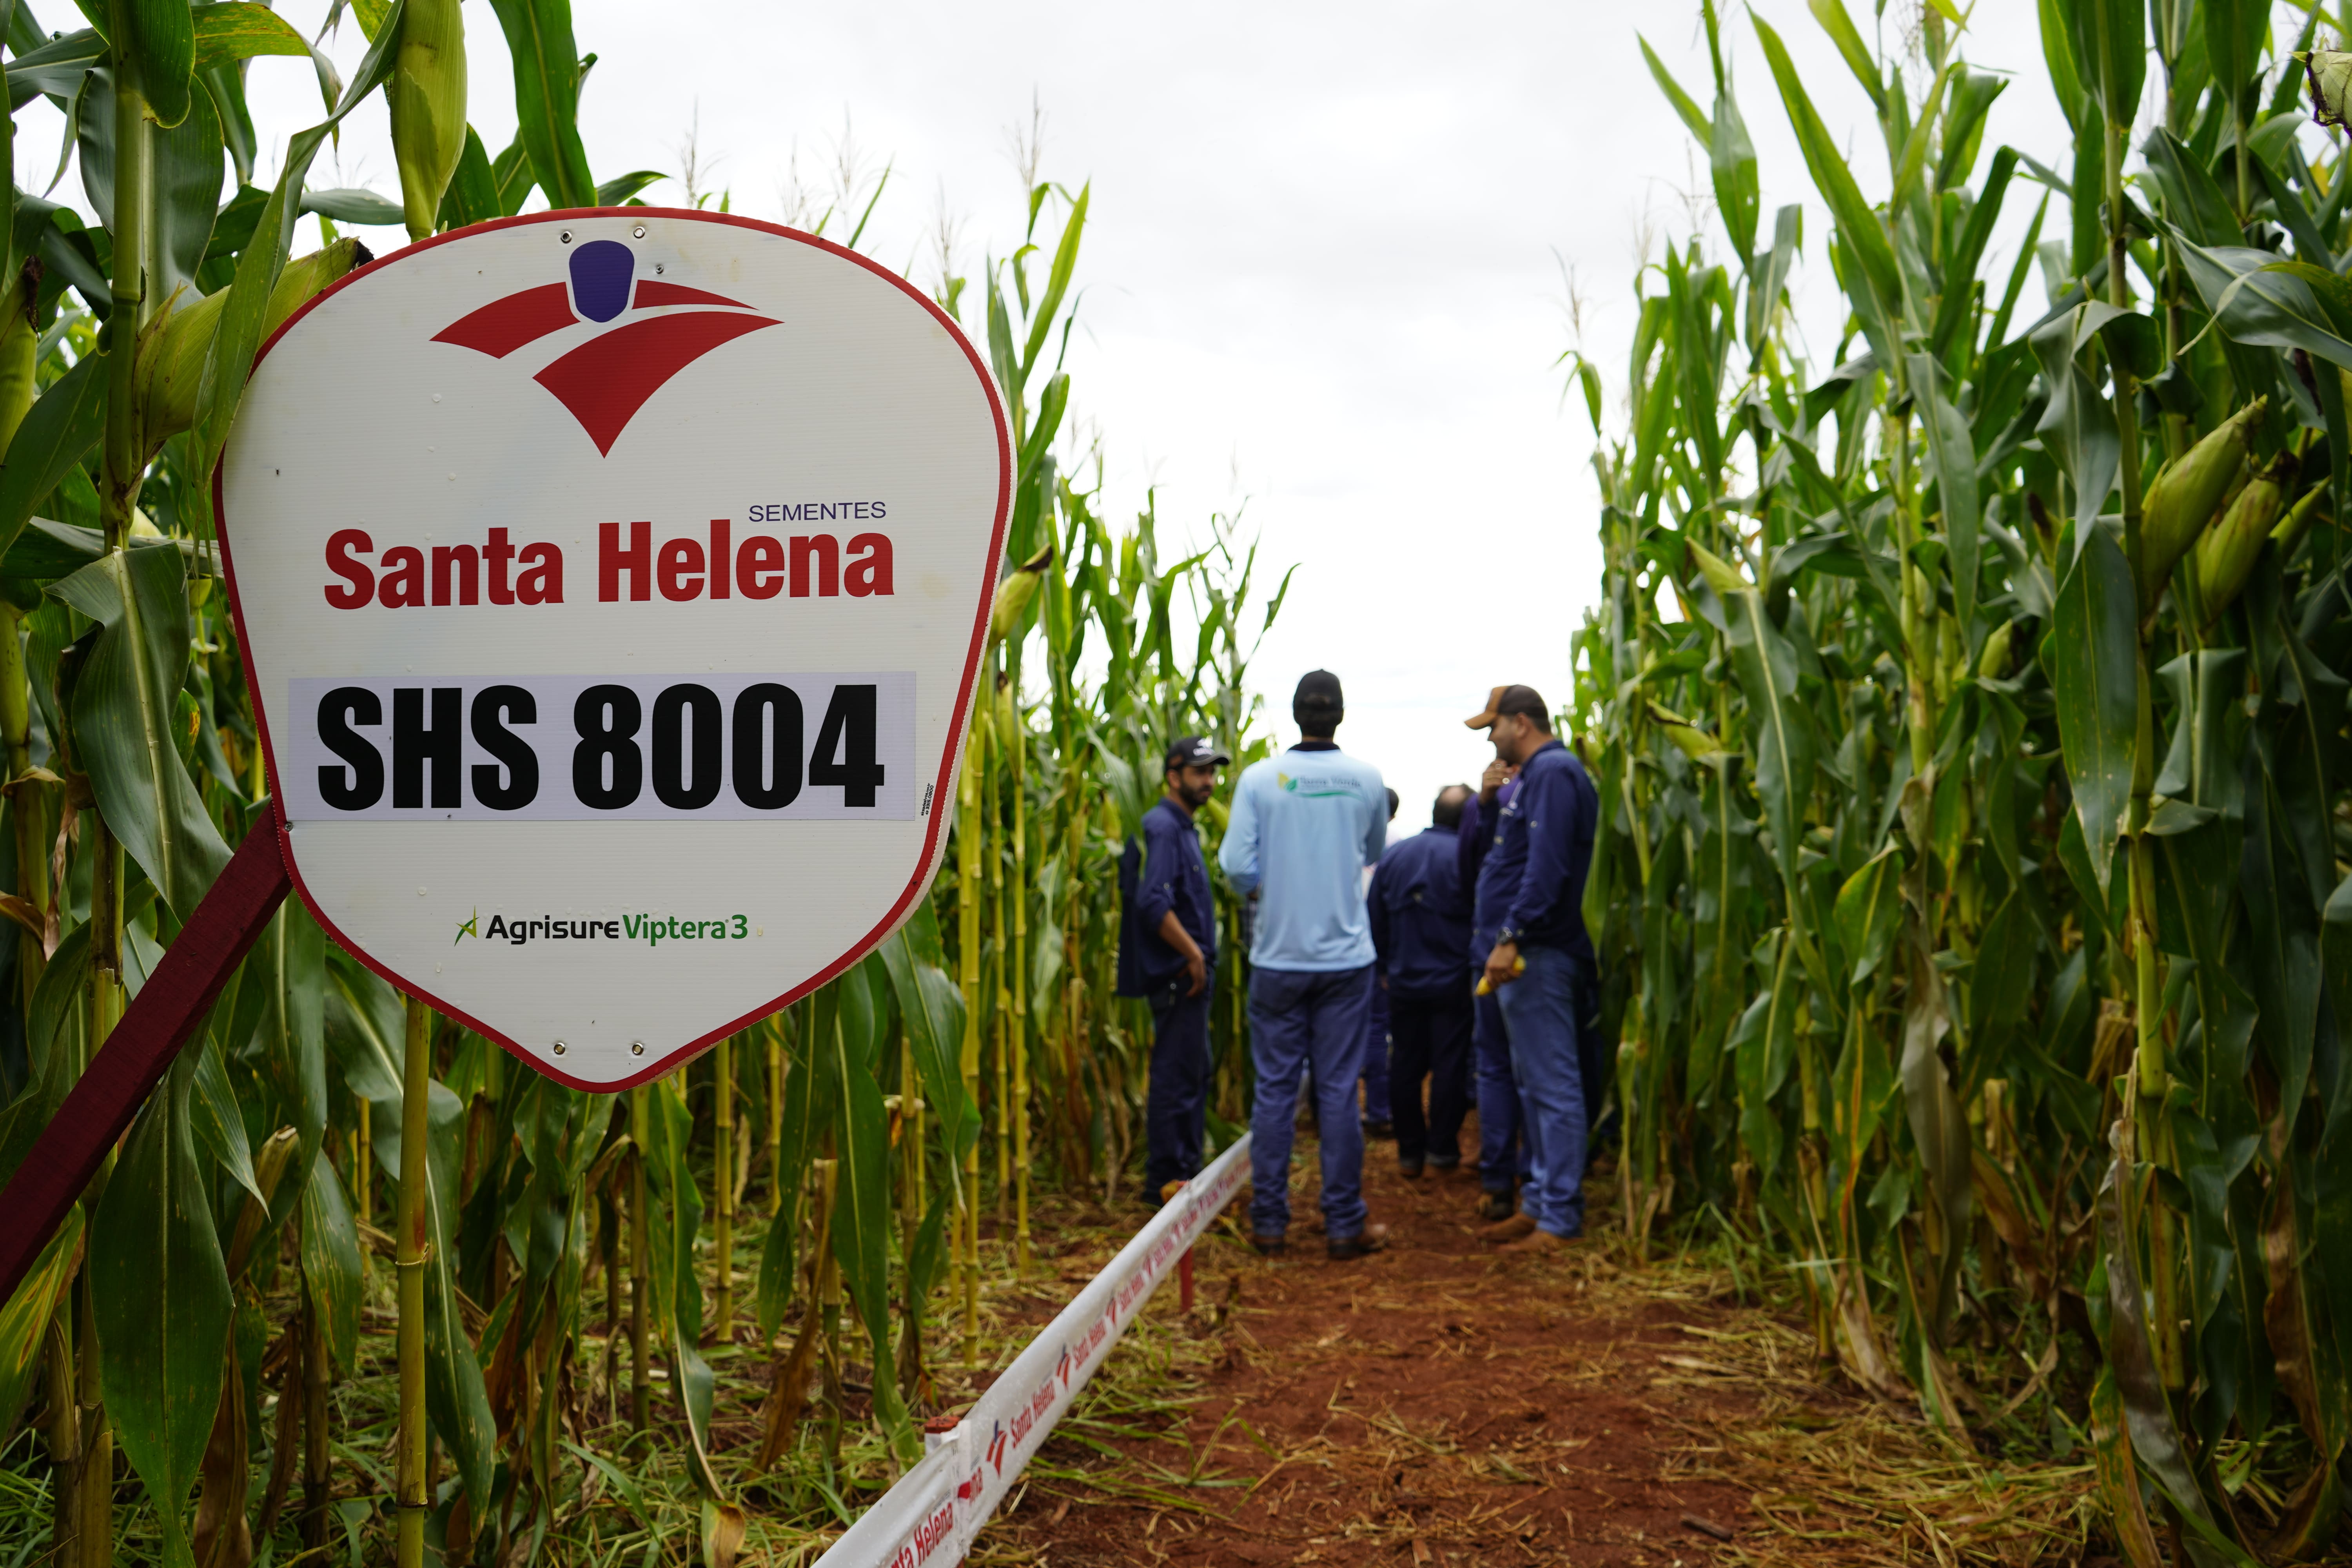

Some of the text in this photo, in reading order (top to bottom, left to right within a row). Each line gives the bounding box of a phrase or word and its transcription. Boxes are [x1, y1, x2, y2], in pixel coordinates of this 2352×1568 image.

[750, 502, 886, 522] SEMENTES
[325, 519, 894, 610] Santa Helena
[318, 683, 885, 811] SHS 8004
[926, 785, 934, 810] 3315.0800
[1032, 1379, 1056, 1422] Helena
[914, 1502, 953, 1566] Helena
